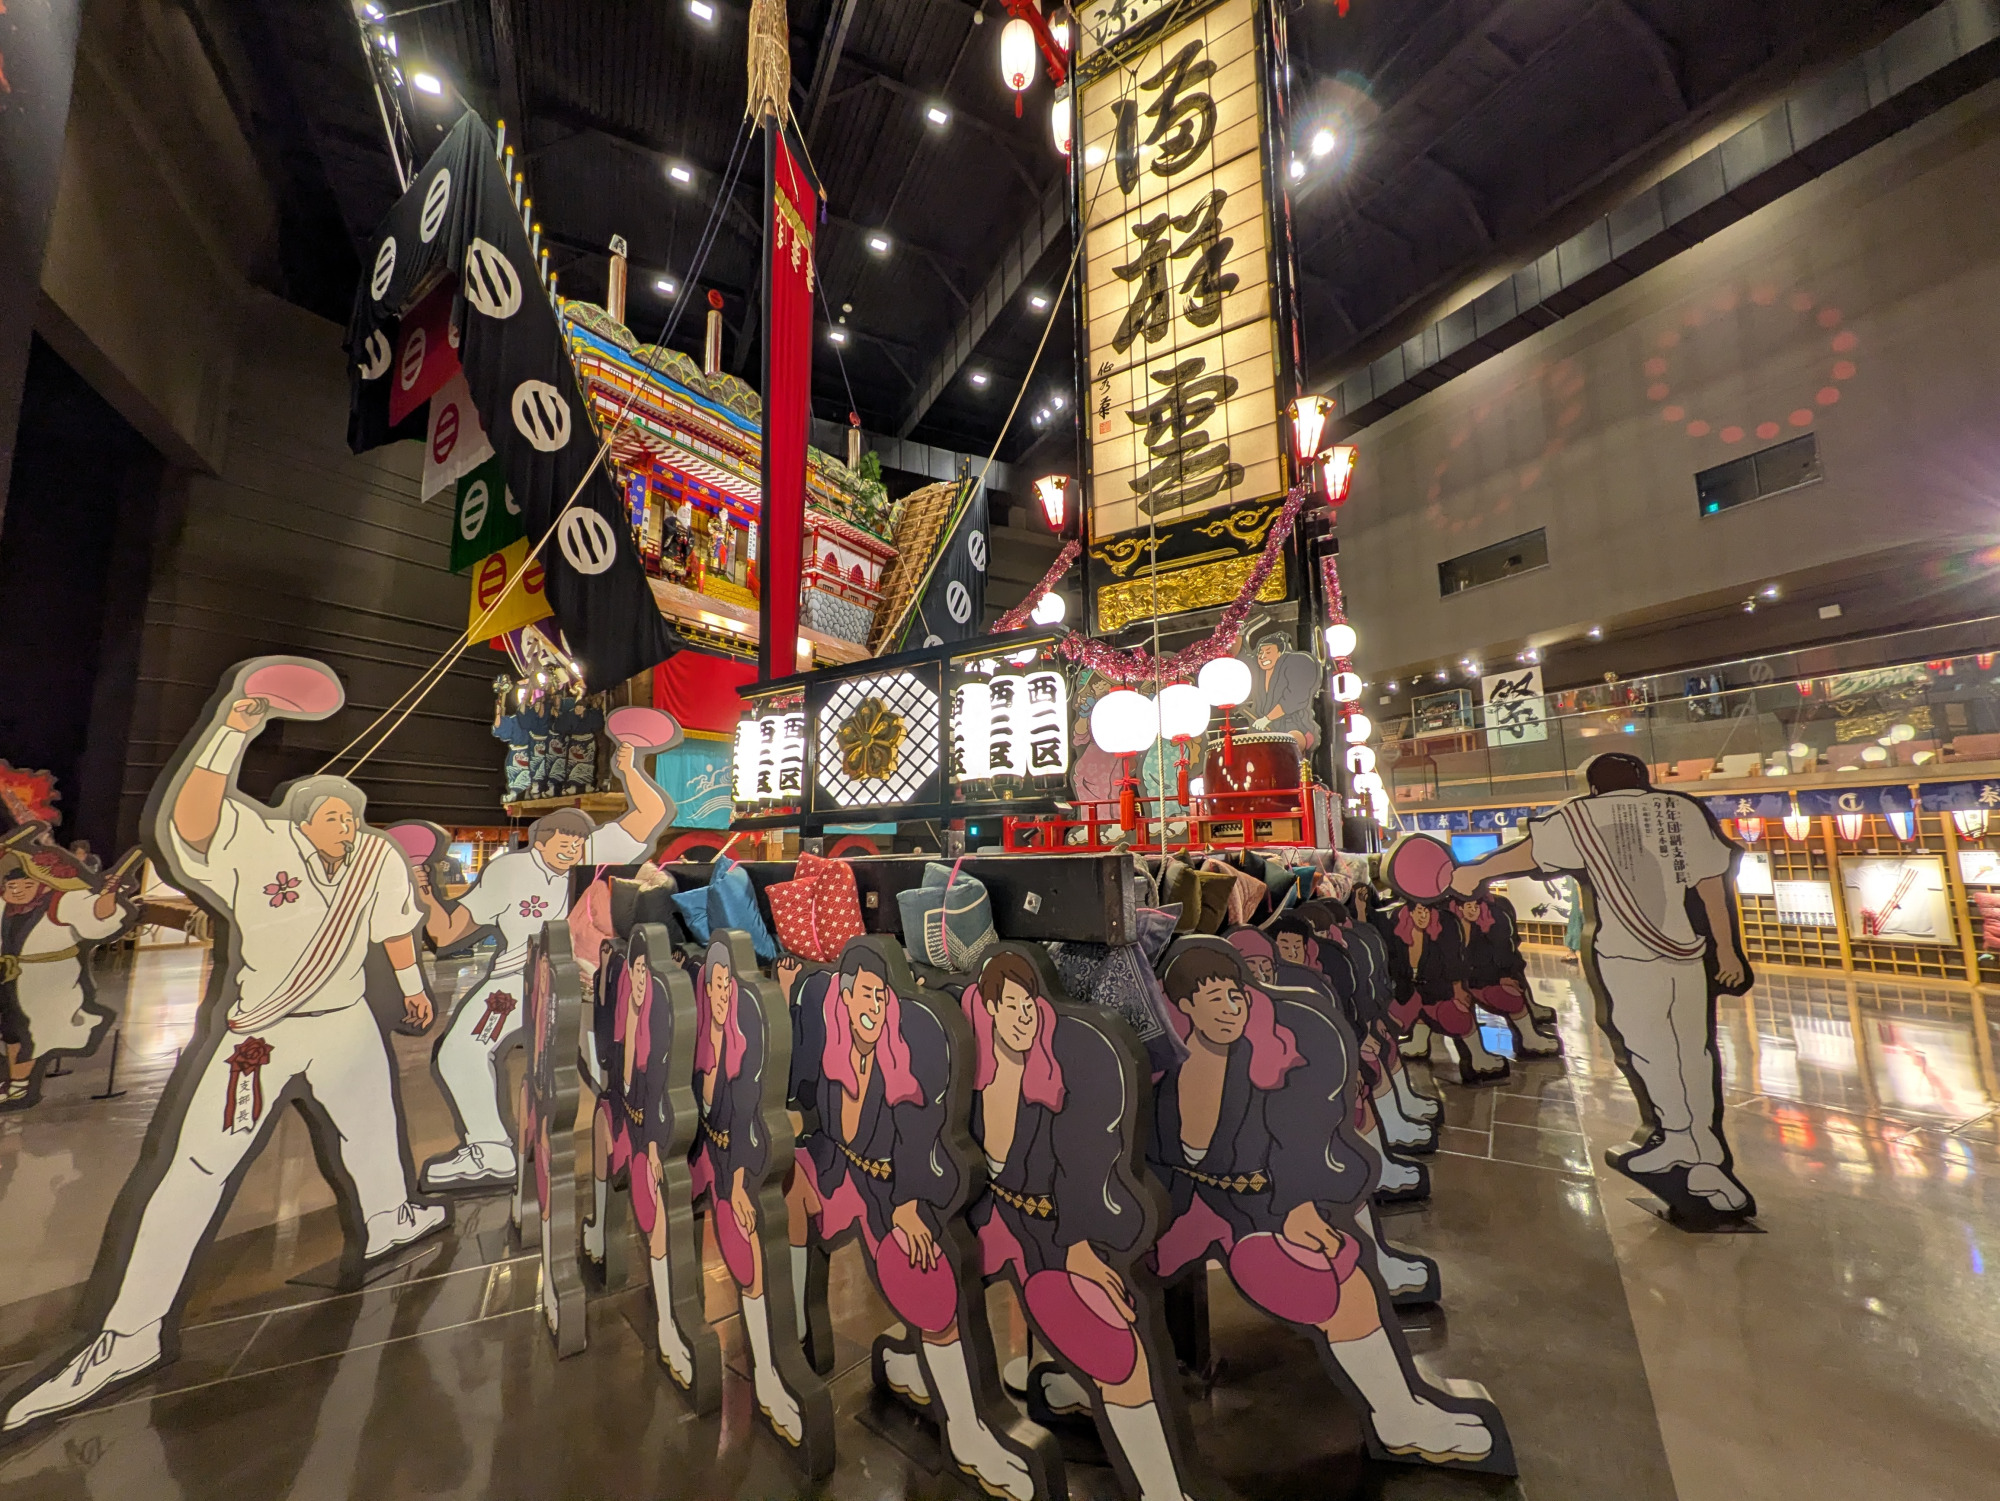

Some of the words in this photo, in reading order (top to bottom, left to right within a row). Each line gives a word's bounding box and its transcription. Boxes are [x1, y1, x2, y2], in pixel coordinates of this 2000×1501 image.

[1027, 675, 1063, 769] 西二区
[236, 1080, 250, 1123] 支部長
